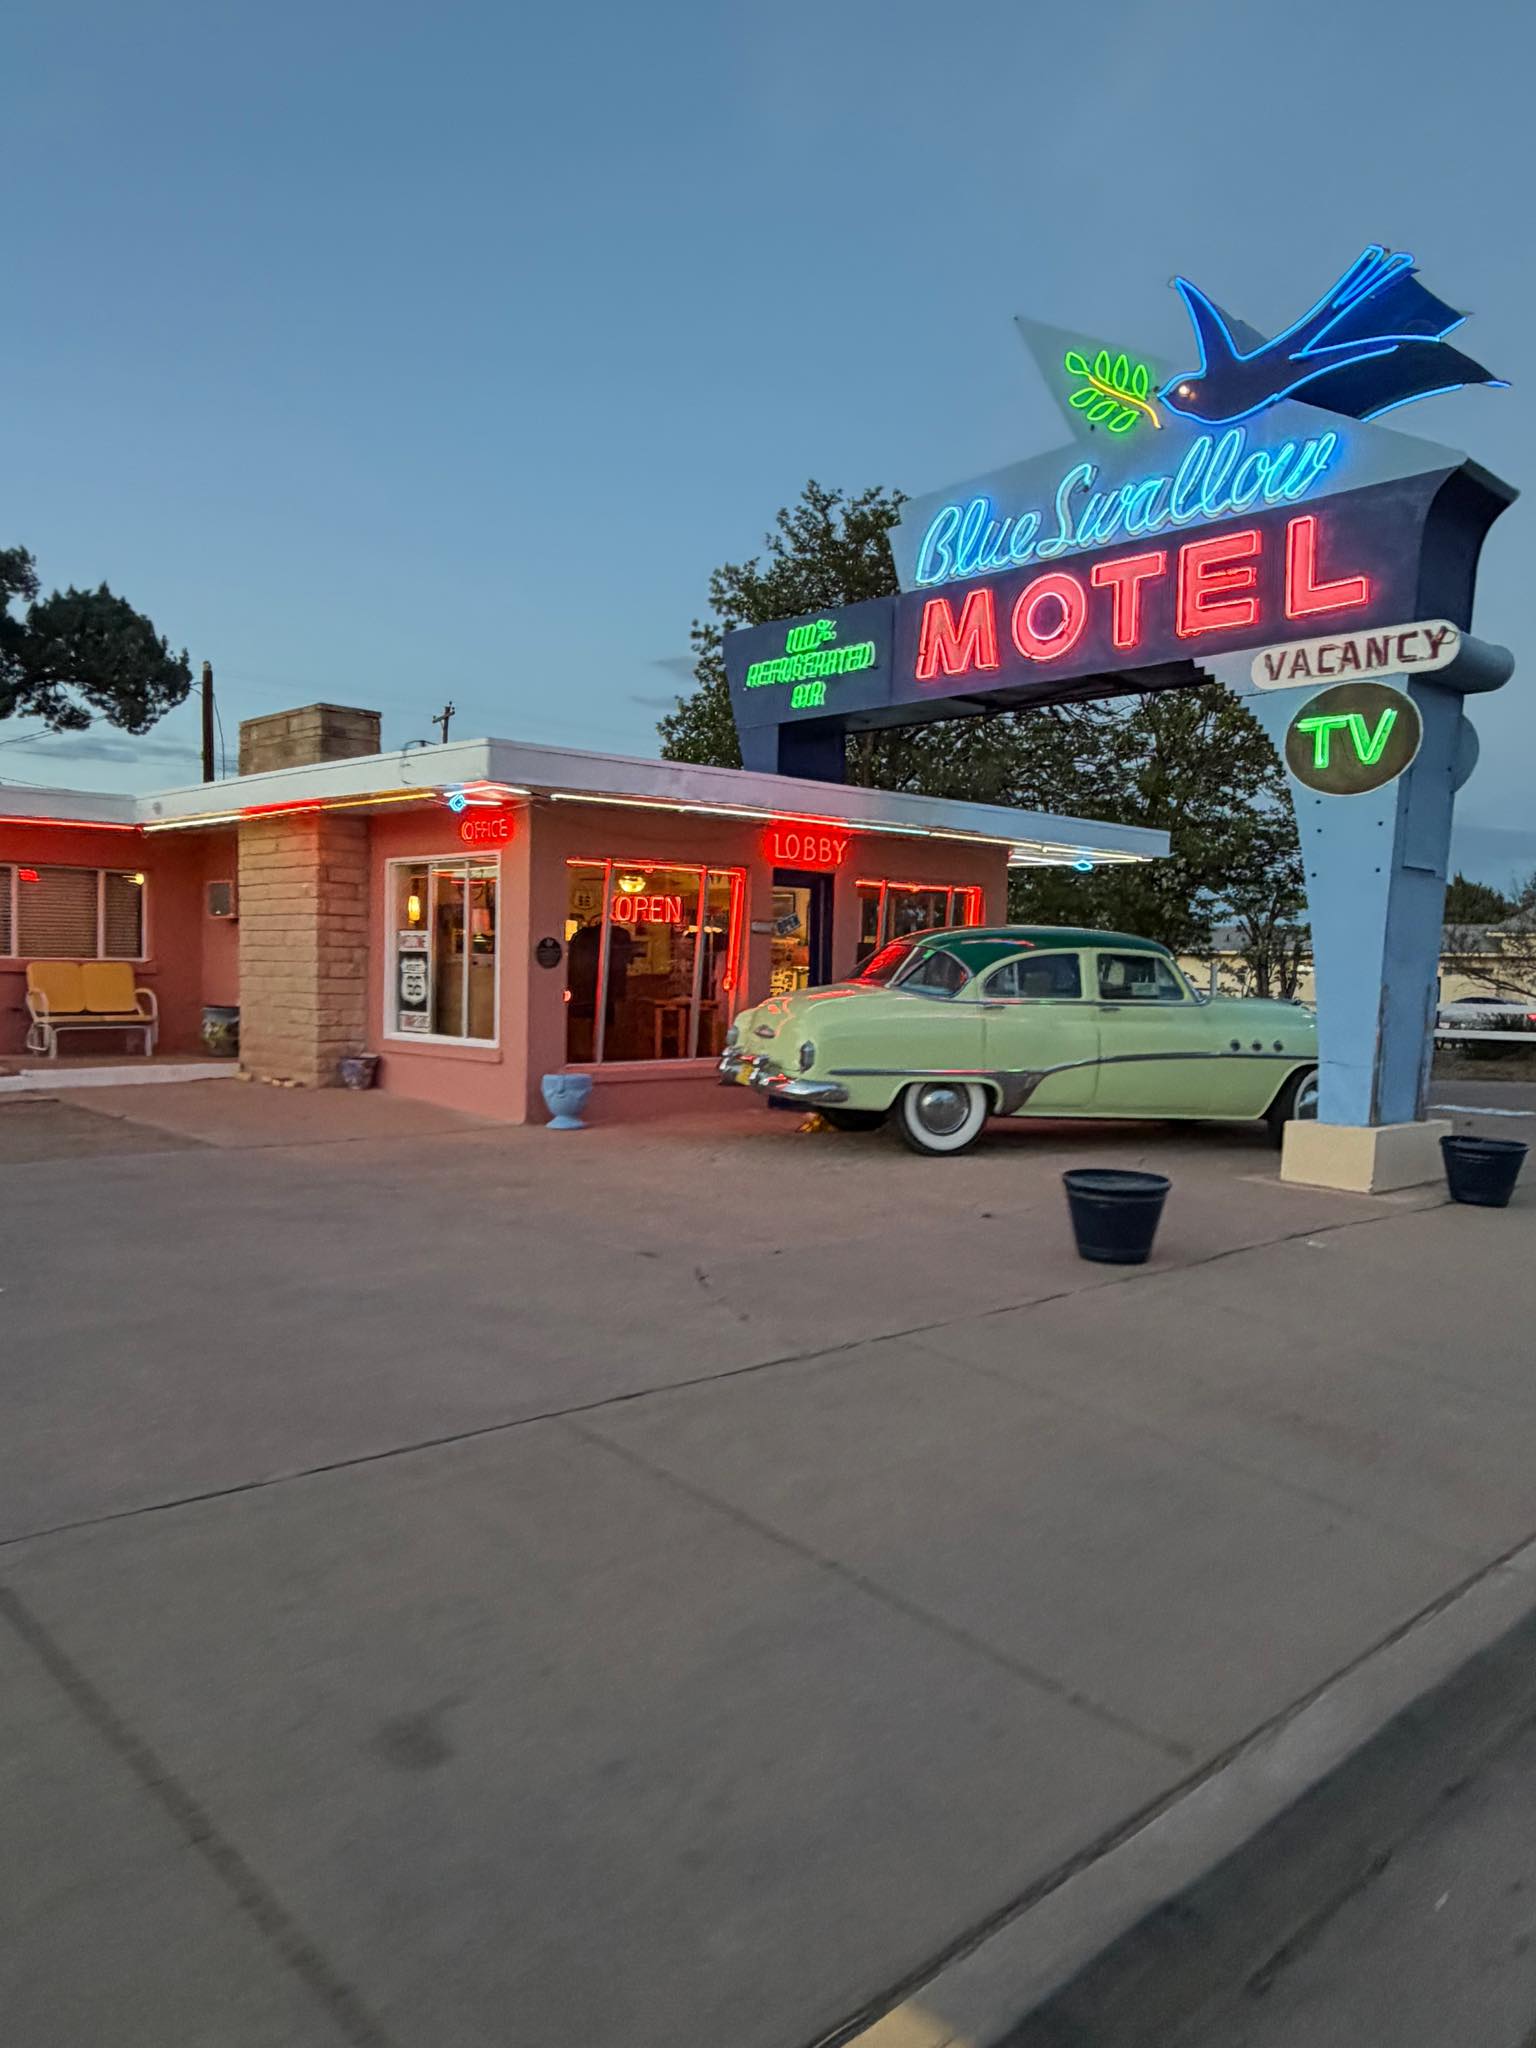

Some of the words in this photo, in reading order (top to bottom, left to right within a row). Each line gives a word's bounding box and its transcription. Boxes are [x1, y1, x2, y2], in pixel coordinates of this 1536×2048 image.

[916, 496, 1041, 587] Blue
[1036, 428, 1338, 559] Swallow
[915, 515, 1370, 681] MOTEL
[786, 619, 837, 653] 100%
[1262, 624, 1458, 683] VACANCY
[791, 681, 827, 708] AIR
[1297, 707, 1399, 770] TV
[460, 818, 508, 841] OFFICE
[774, 833, 848, 865] LOBBY
[614, 895, 682, 923] OPEN
